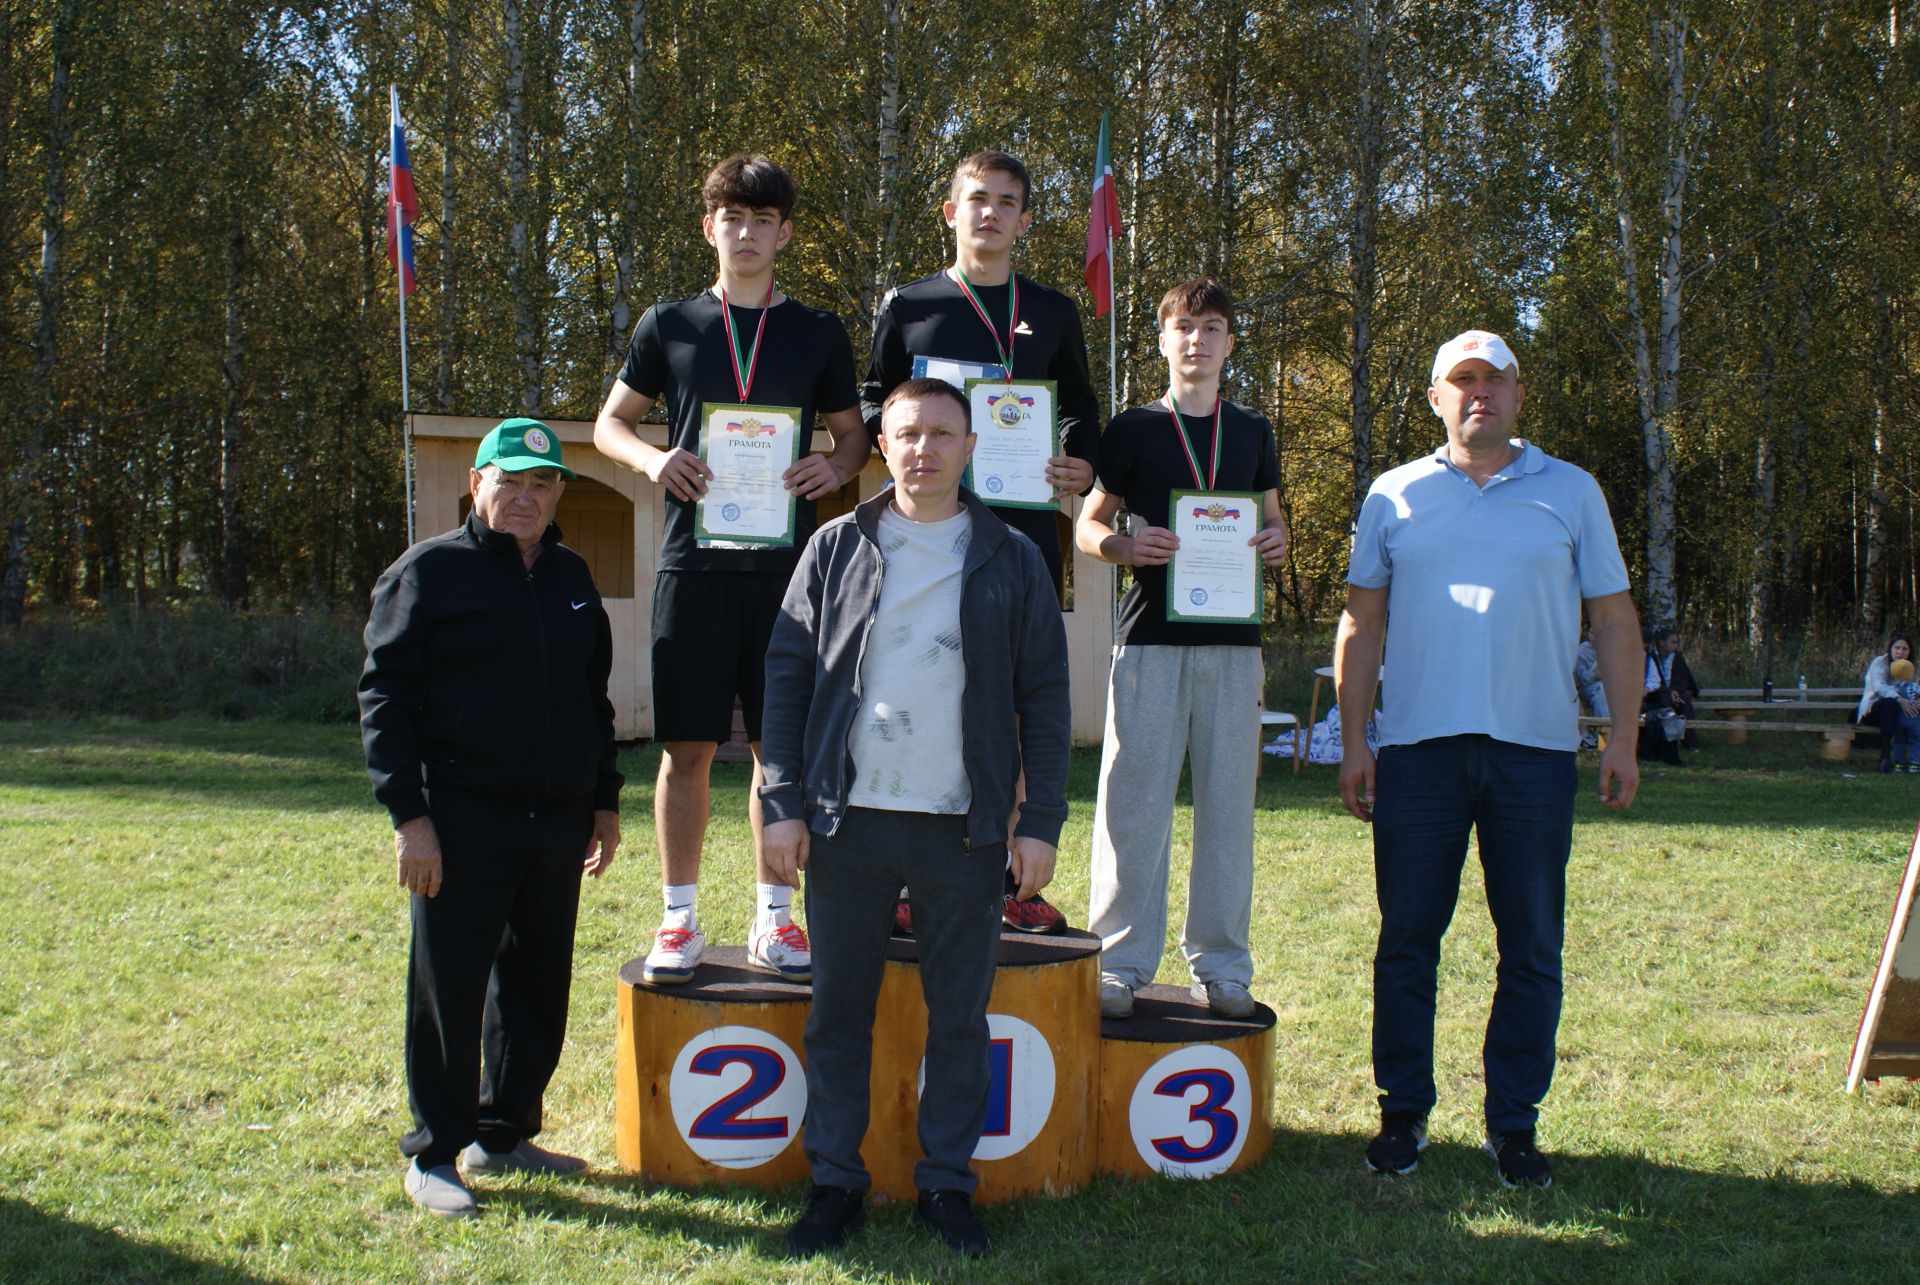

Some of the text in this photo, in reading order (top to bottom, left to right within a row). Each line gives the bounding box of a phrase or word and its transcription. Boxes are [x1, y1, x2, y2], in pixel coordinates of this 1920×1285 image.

[728, 439, 772, 449] ГРАМОТА
[1195, 524, 1237, 533] ГРАМОТА
[688, 1044, 789, 1140] 2
[1150, 1068, 1240, 1164] 3
